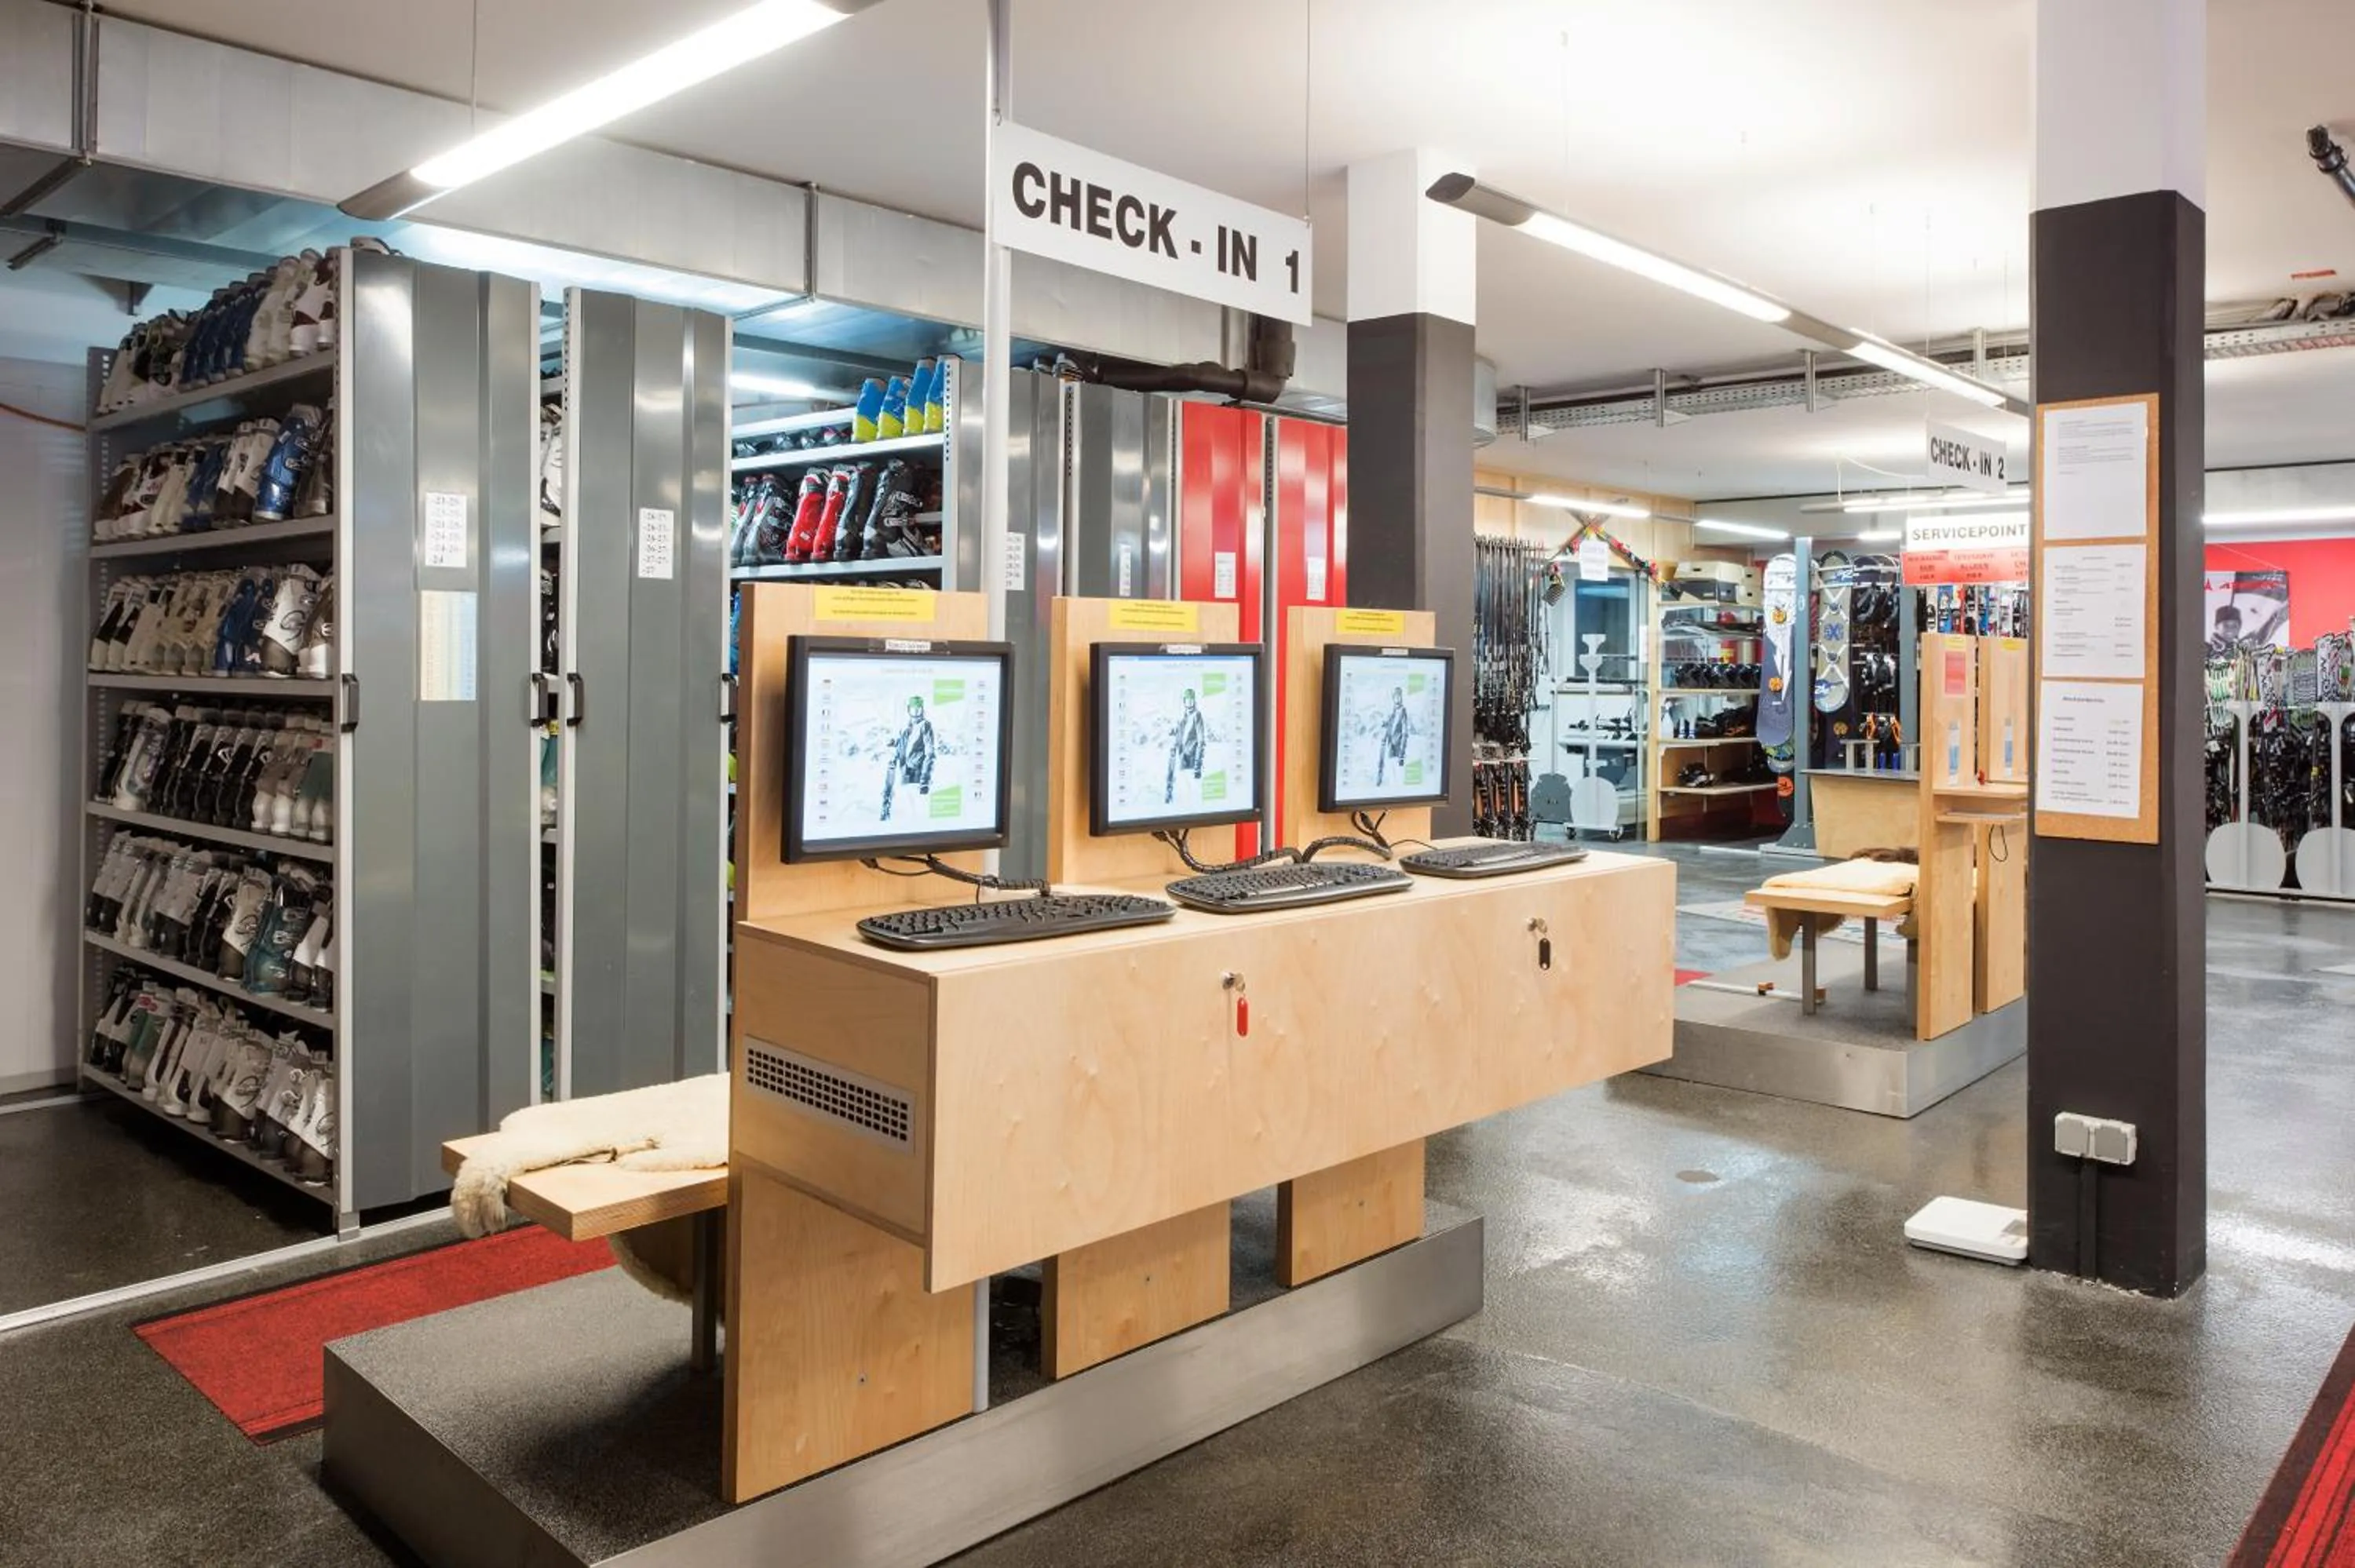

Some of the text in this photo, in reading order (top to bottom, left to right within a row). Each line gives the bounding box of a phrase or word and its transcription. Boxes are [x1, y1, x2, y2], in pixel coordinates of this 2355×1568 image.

[1012, 162, 1178, 260] CHECK
[1218, 224, 1257, 282] IN
[1285, 250, 1299, 294] 1
[1930, 436, 1970, 472] CHECK
[1980, 451, 1992, 477] IN
[1998, 456, 2004, 480] 2
[1913, 524, 2026, 541] SERVICEPOINT
